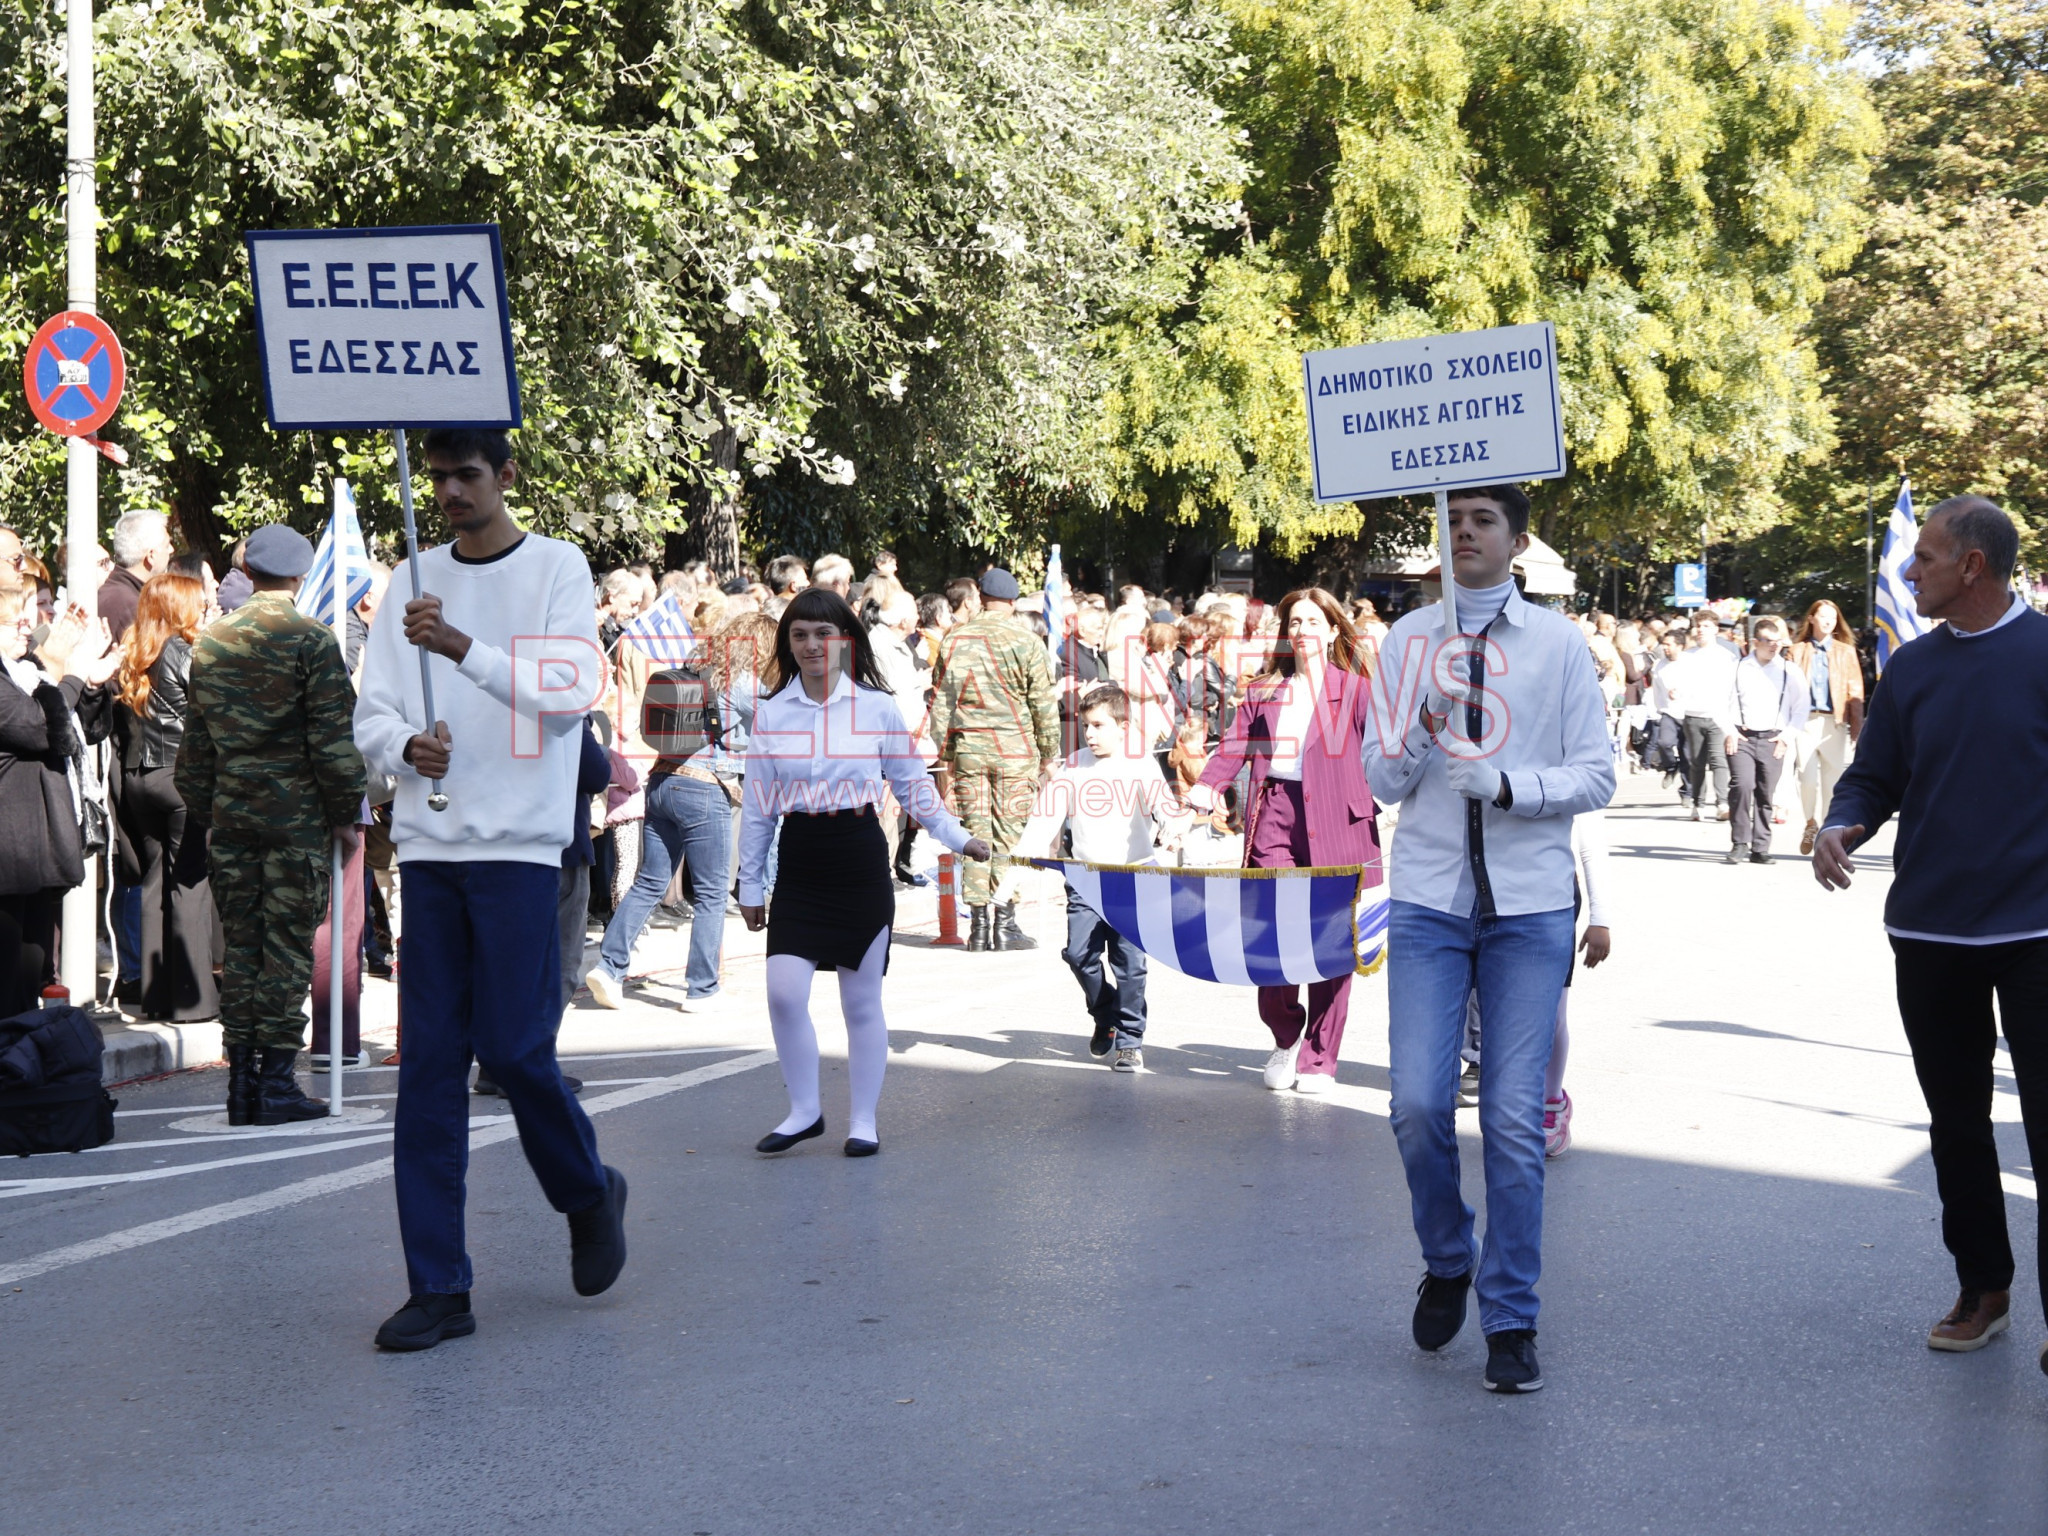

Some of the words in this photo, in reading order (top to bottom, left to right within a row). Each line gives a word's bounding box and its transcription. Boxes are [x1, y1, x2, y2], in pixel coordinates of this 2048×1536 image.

[282, 262, 485, 309] Ε.Ε.Ε.Ε.Κ
[289, 339, 481, 375] ΕΔΕΣΣΑΣ
[1318, 362, 1433, 396] ΔΗΜΟΤΙΚΟ
[1446, 348, 1543, 381] ΣΧΟΛΕΙΟ
[1342, 405, 1431, 435] ΕΙΔΙΚΗΣ
[1437, 393, 1525, 423] ΑΓΩΓΗΣ
[1391, 440, 1490, 471] ΕΔΕΣΣΑΣ
